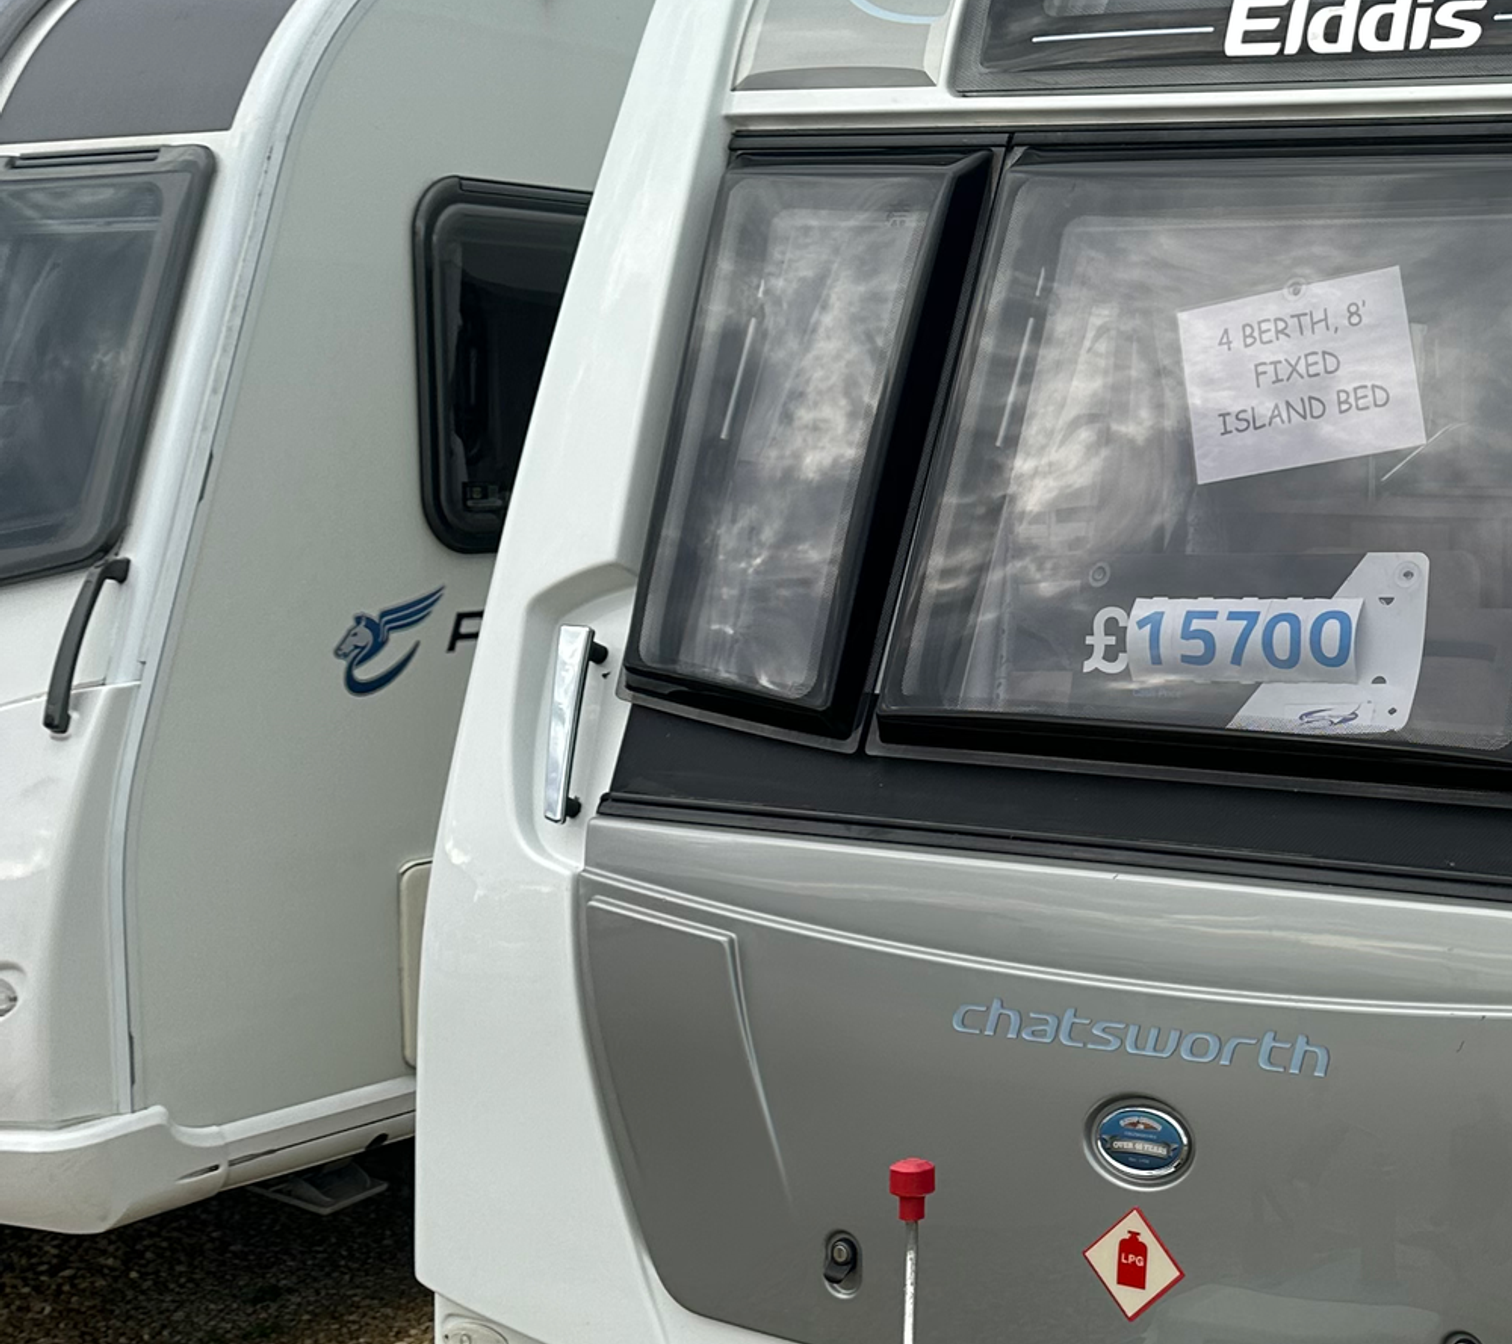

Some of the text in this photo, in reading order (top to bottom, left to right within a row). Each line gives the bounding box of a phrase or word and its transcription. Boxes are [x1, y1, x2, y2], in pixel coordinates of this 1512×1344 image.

[1217, 327, 1234, 351] 4
[1241, 307, 1340, 349] BERTH,
[1253, 349, 1341, 388] FIXED
[1217, 383, 1391, 436] ISLAND BED
[1083, 606, 1354, 674] £15700
[951, 998, 1332, 1078] chatsworth
[1121, 1252, 1144, 1267] LPG
